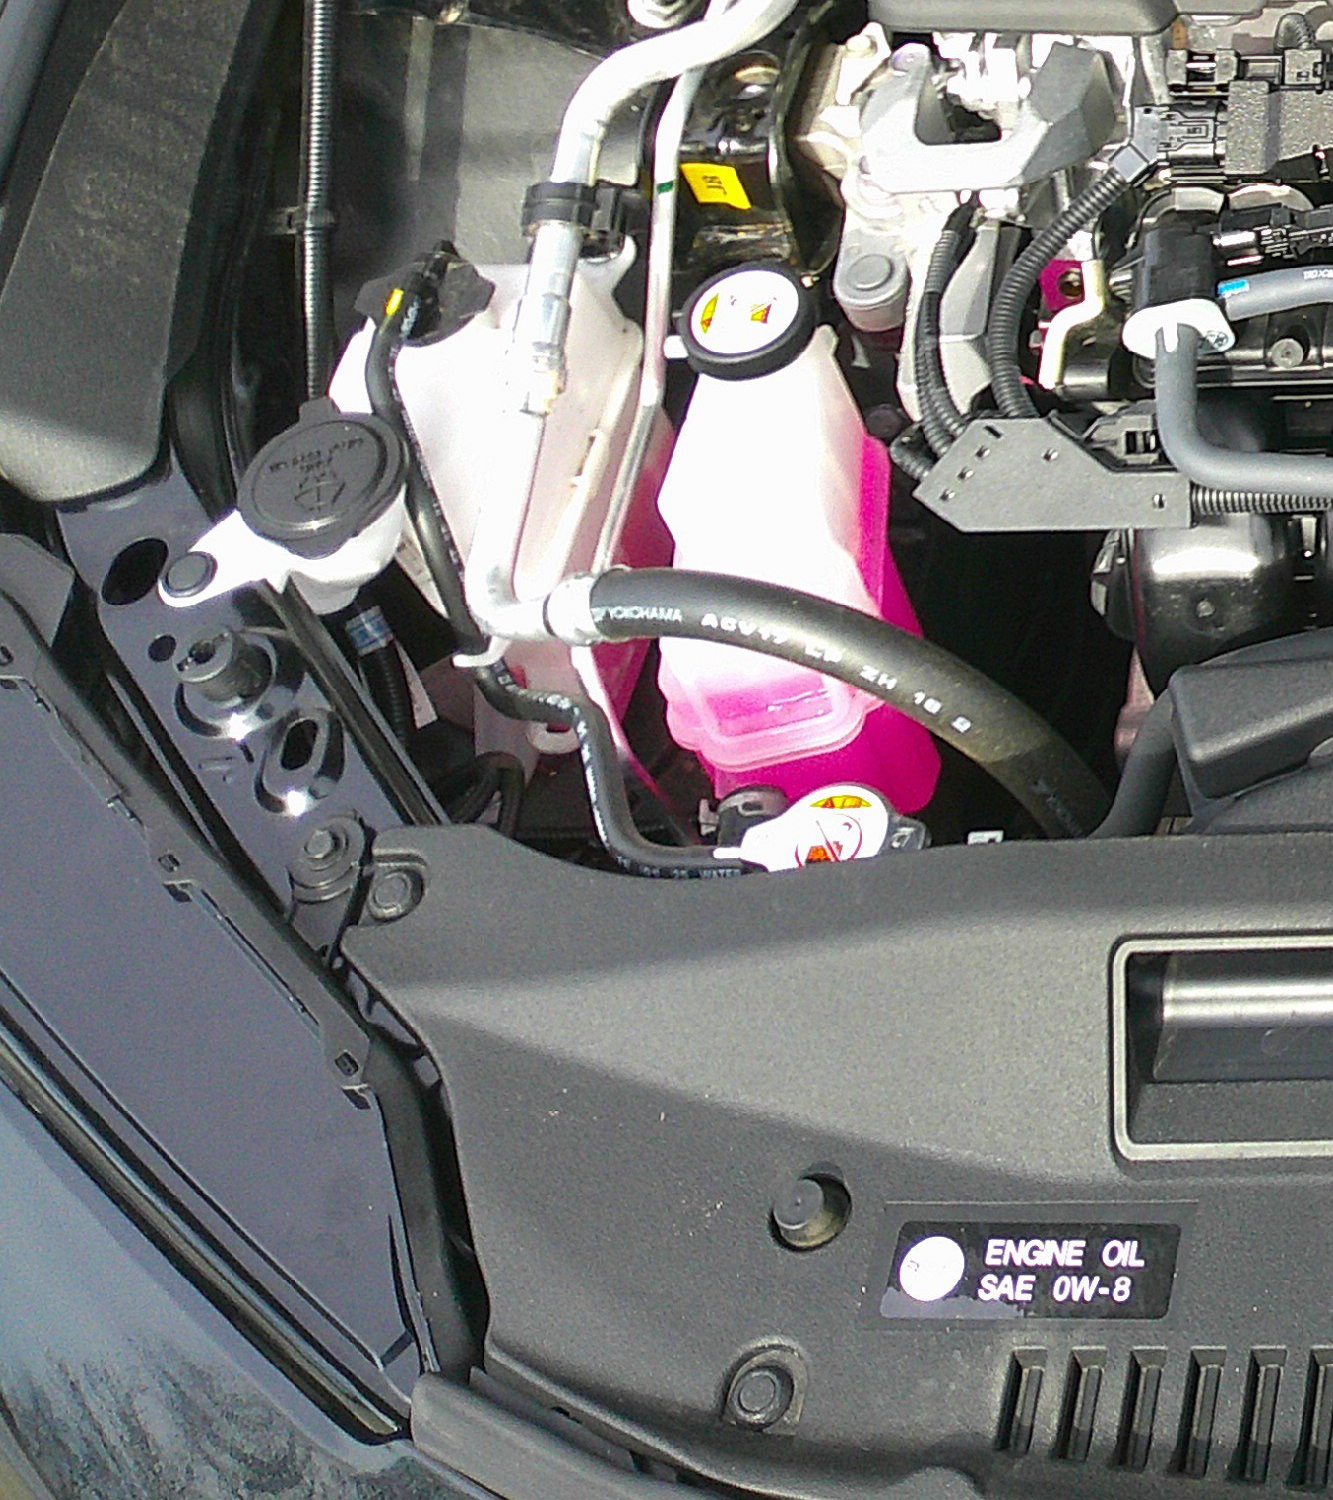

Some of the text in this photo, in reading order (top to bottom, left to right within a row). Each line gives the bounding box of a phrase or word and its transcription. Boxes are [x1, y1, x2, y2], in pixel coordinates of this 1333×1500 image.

[985, 1239, 1145, 1268] ENGINE OIL
[977, 1274, 1131, 1303] SAE 0W-8
